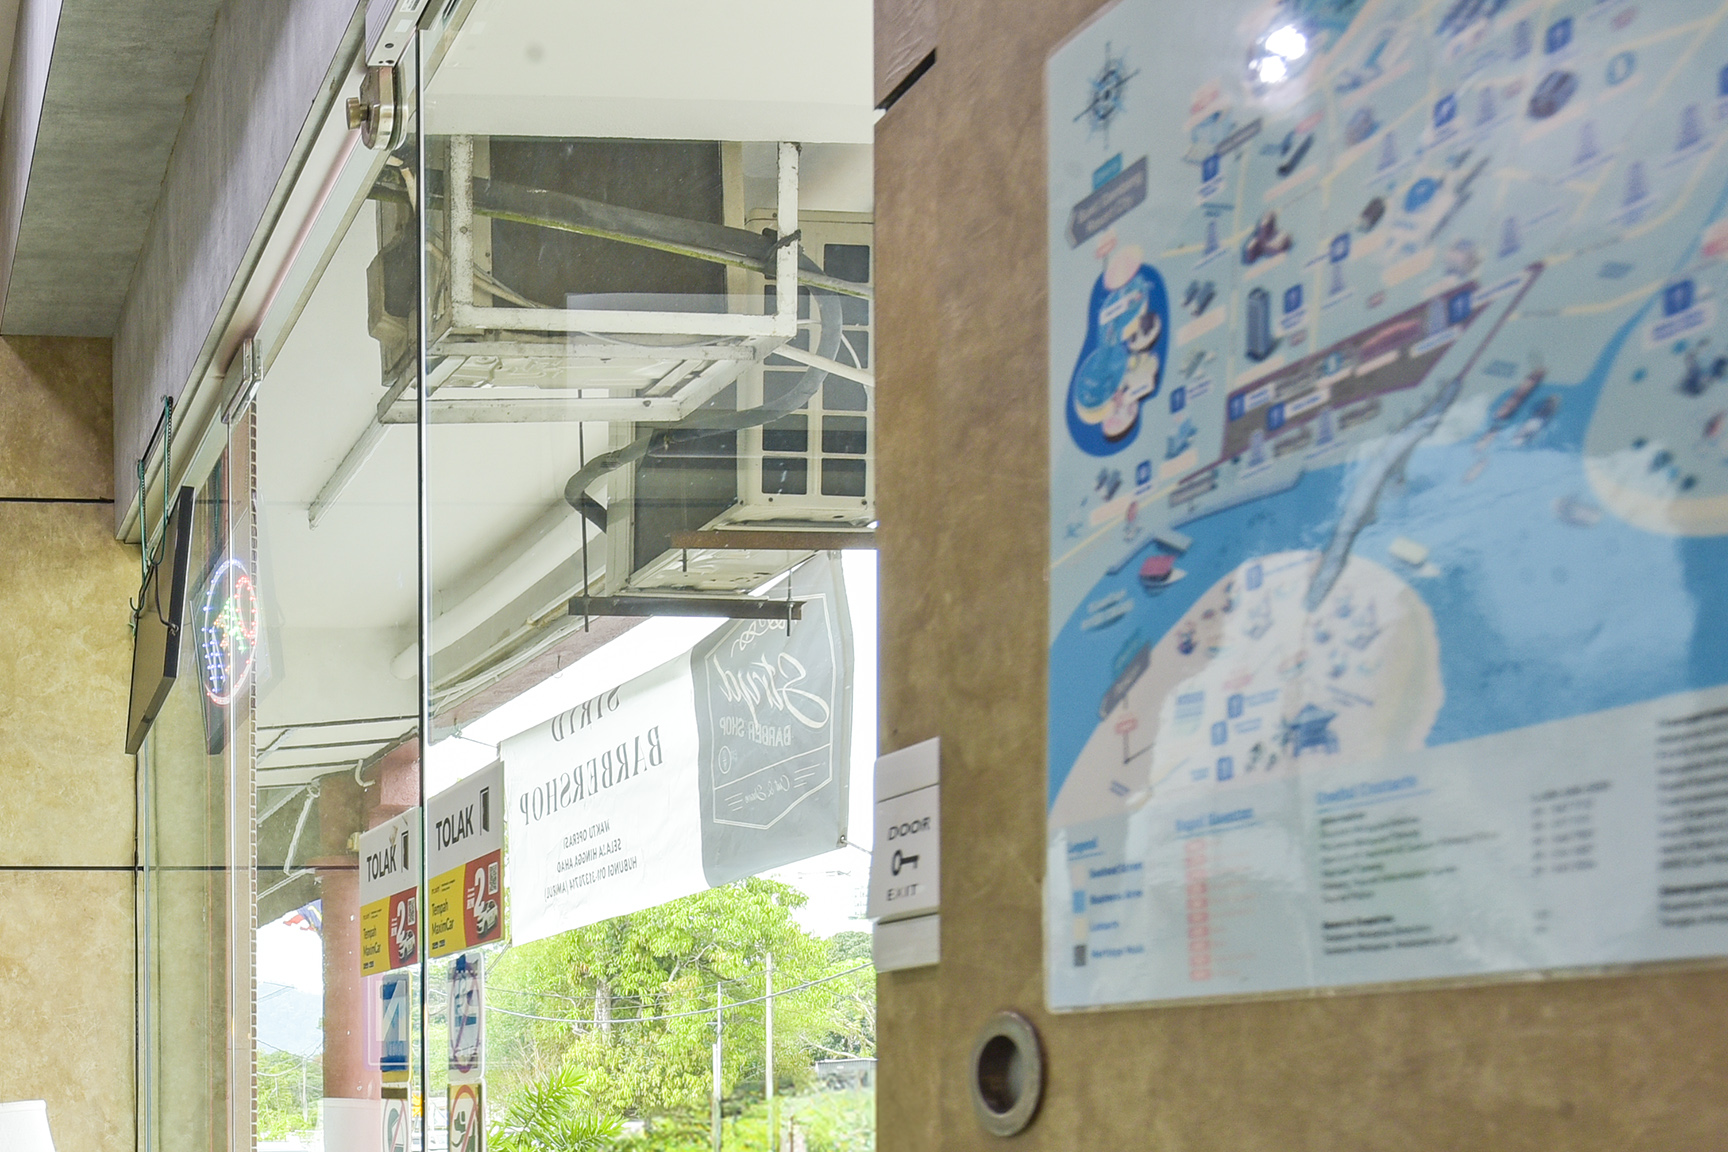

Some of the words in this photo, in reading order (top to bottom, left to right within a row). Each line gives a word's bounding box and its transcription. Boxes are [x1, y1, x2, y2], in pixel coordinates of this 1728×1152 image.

[436, 804, 474, 851] TOLAK
[888, 817, 931, 841] DOOR
[367, 844, 396, 882] TOLAK
[887, 883, 919, 901] EXIT
